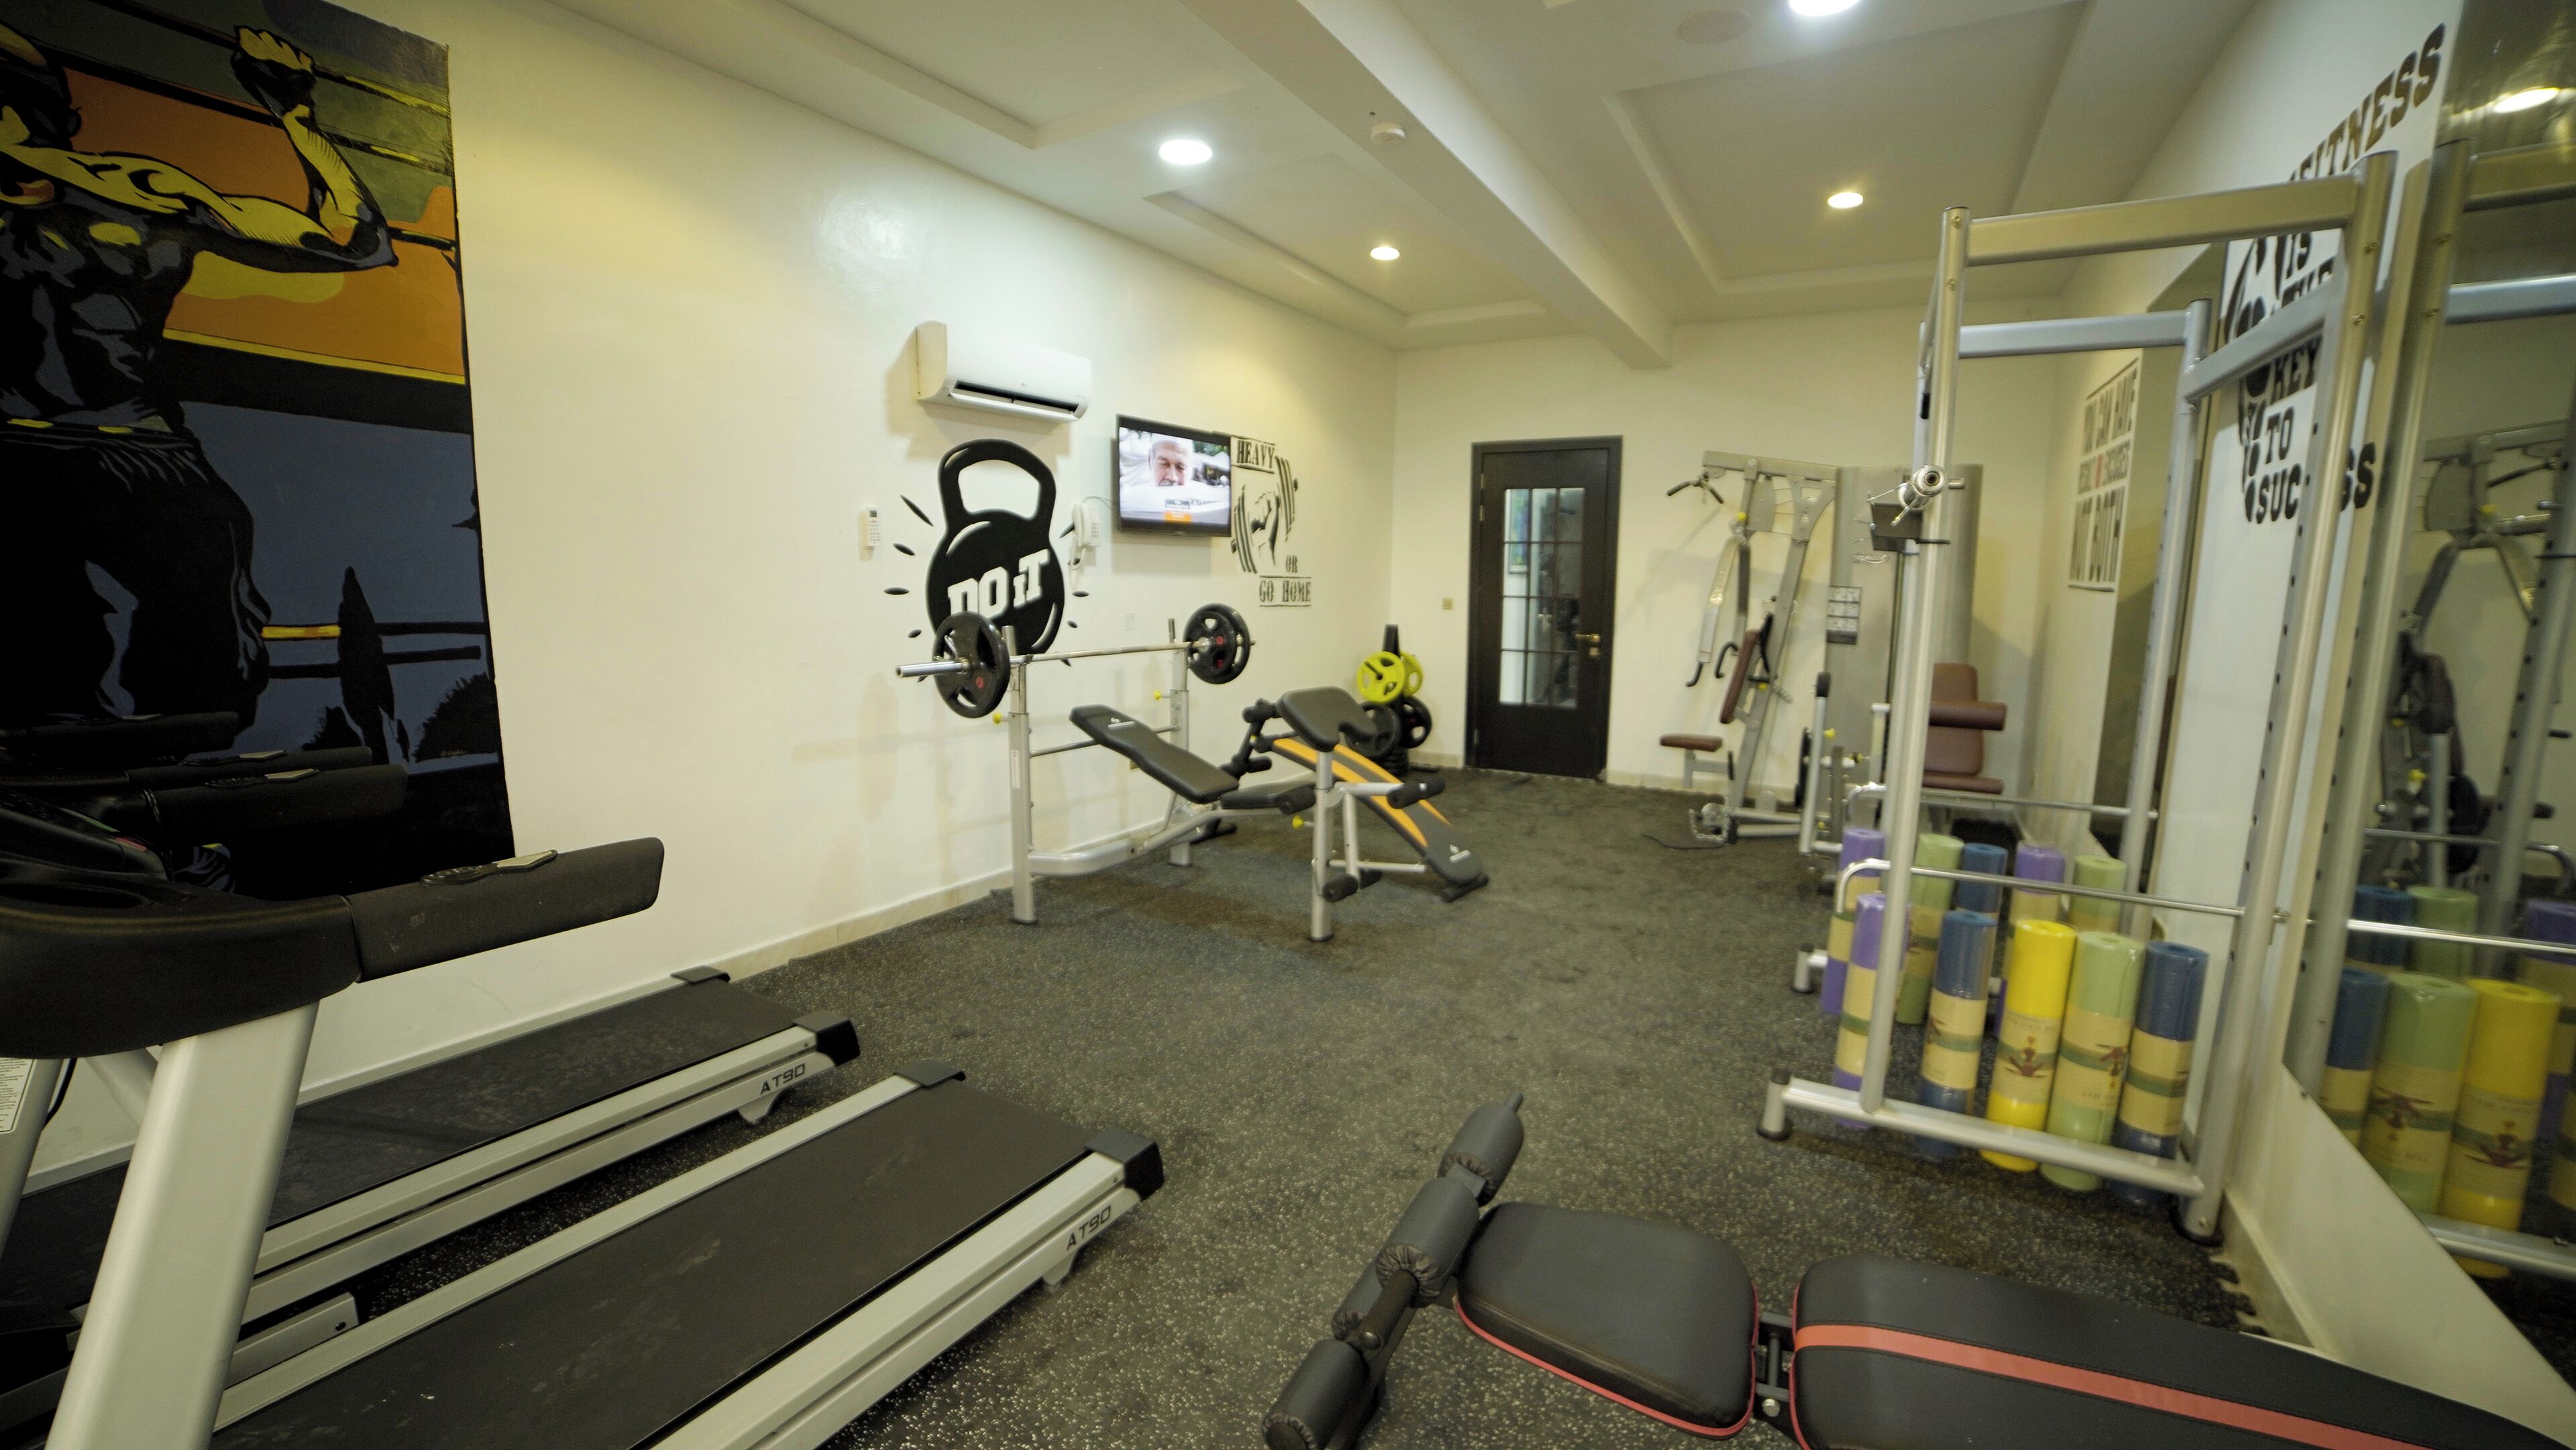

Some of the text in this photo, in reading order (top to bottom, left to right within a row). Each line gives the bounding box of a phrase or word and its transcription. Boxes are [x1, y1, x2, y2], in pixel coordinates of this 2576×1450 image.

[2265, 406, 2295, 464] TO
[1236, 439, 1275, 468] HEAVY
[1285, 555, 1298, 573] OR
[1259, 580, 1311, 603] GO HOME
[759, 1062, 806, 1095] AT90
[1065, 1204, 1112, 1251] AT90
